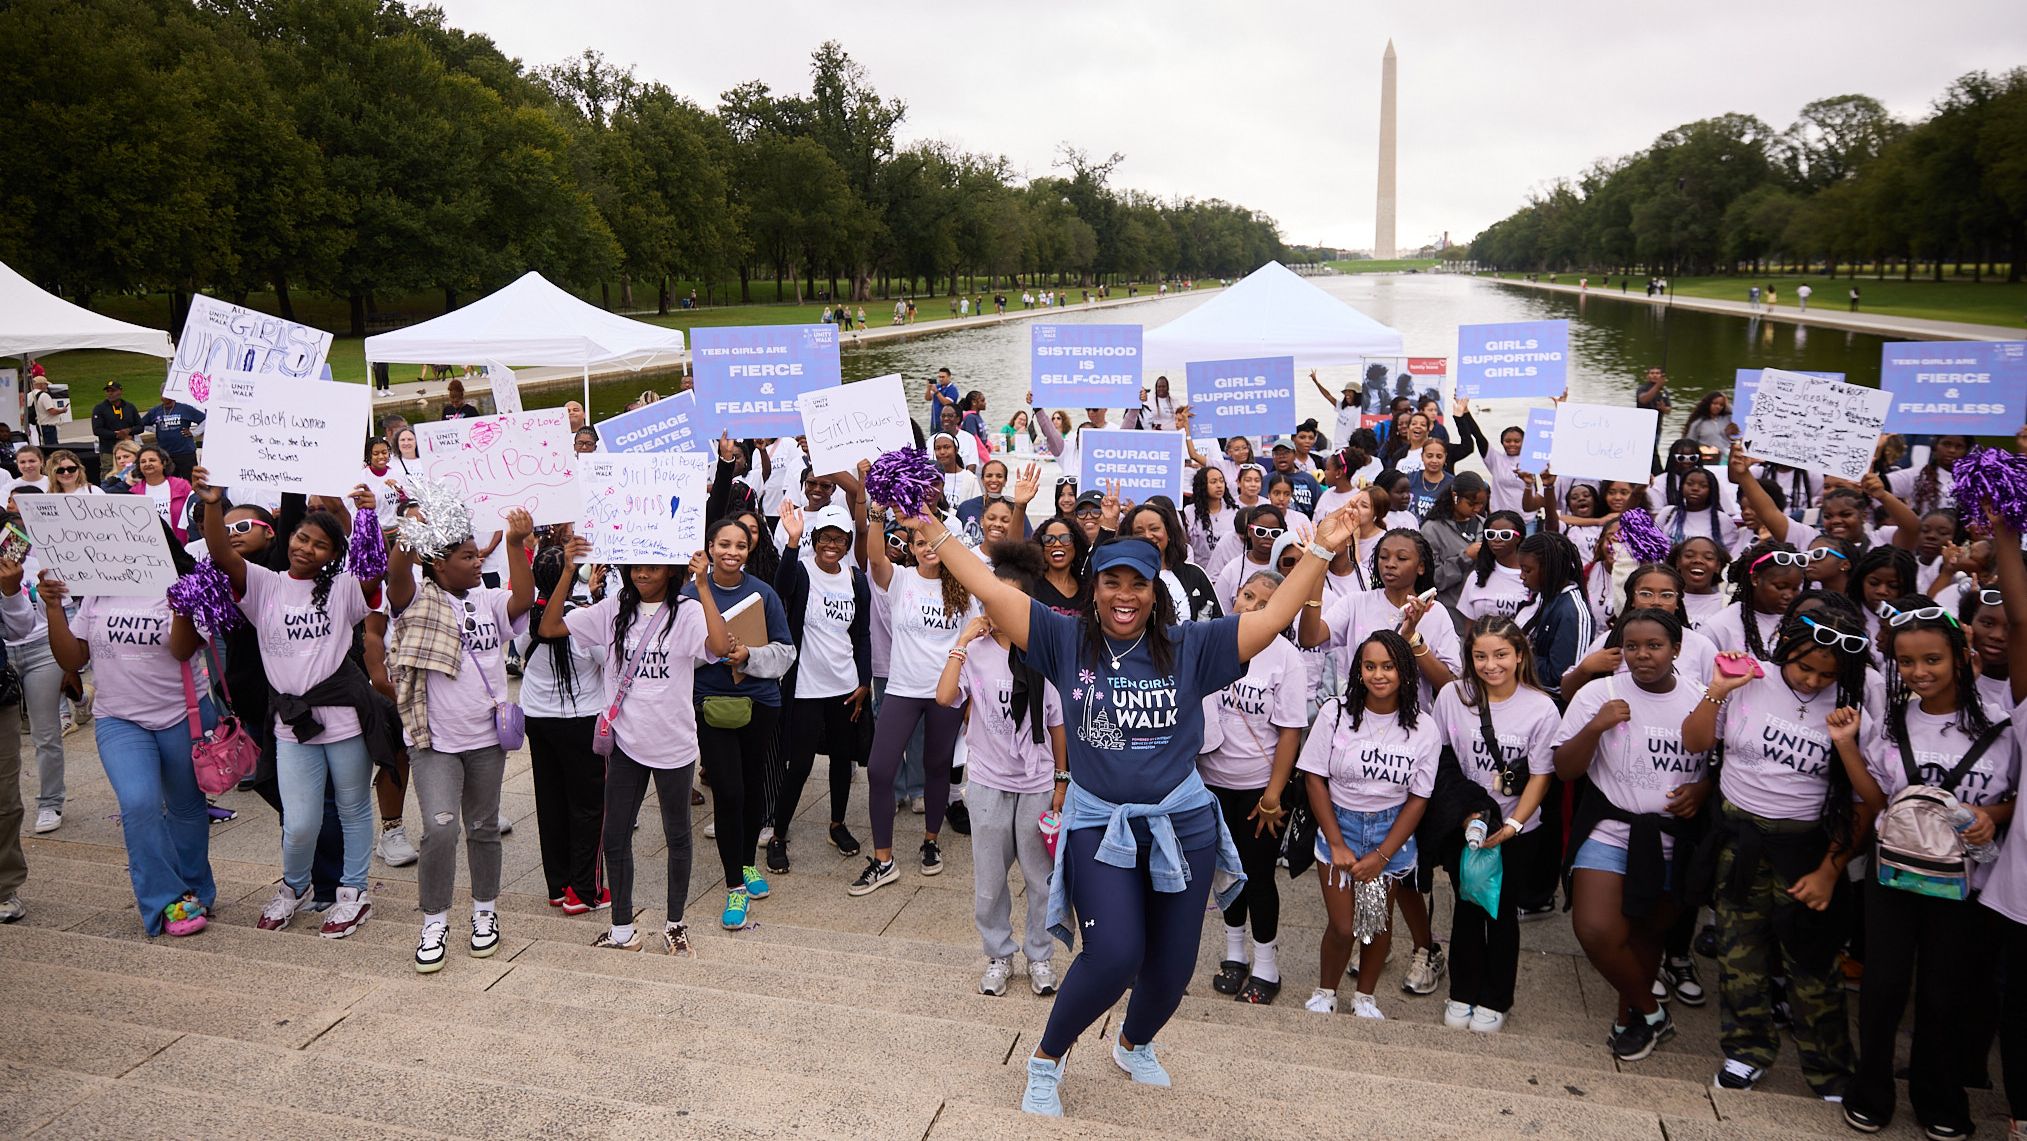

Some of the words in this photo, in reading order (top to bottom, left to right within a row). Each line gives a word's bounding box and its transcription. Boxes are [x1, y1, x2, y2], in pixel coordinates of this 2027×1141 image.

[209, 310, 229, 320] UNITY
[231, 306, 248, 315] ALL
[209, 316, 228, 327] WALK
[731, 347, 765, 355] GIRLS
[766, 346, 788, 354] ARE
[1037, 346, 1137, 357] SISTERHOOD
[1485, 339, 1538, 351] GIRLS
[1079, 360, 1095, 370] IS
[1462, 352, 1562, 365] SUPPORTING
[729, 363, 804, 377] FIERCE
[1484, 366, 1538, 378] GIRLS
[1040, 374, 1133, 385] SELF-CARE
[1214, 376, 1267, 389] GIRLS
[1916, 373, 1991, 384] FIERCE
[231, 383, 255, 391] UNITY
[760, 382, 775, 395] &
[1943, 388, 1960, 398] &
[232, 390, 254, 398] WALK
[1192, 388, 1290, 403] SUPPORTING
[715, 400, 801, 414] FEARLES
[1215, 403, 1268, 416] GIRLS
[1898, 403, 2006, 414] FEARLESS
[219, 406, 244, 424] The
[247, 408, 286, 428] Black
[615, 412, 689, 446] COURAGE
[810, 414, 851, 444] Girl
[1093, 449, 1170, 461] COURAGE
[1094, 463, 1168, 475] CREATES
[1095, 477, 1166, 489] CHANGE!
[64, 495, 120, 521] Black
[121, 523, 160, 547] have
[36, 545, 81, 565] The
[84, 545, 142, 564] Power
[921, 605, 960, 618] UNIY
[1496, 600, 1520, 611] UNI
[107, 616, 164, 631] UNITY
[923, 617, 958, 630] WALK
[108, 630, 162, 645] WALK
[287, 622, 331, 640] WALK
[634, 666, 670, 679] ALK
[996, 679, 1013, 688] TEE
[1107, 676, 1138, 689] TEEN
[1139, 675, 1175, 690] GIRLS
[1112, 688, 1177, 709] UNITY
[1222, 694, 1265, 715] WALK
[1116, 708, 1178, 729] WALK
[1643, 725, 1674, 737] TEEN
[1765, 712, 1799, 732] TEEN
[1799, 726, 1829, 742] GIRL
[1498, 734, 1529, 745] GIRLS
[1763, 725, 1832, 762] UNITY
[1360, 740, 1386, 751] TEEN
[1386, 744, 1417, 755] GIRLS
[1473, 740, 1526, 759] UITY
[1648, 738, 1705, 756] UNI
[1361, 749, 1415, 771] UNITY
[1763, 743, 1827, 775] WALK
[1953, 755, 1994, 770] GLS
[1362, 765, 1412, 786] WALK
[1919, 768, 1993, 790] UTY
